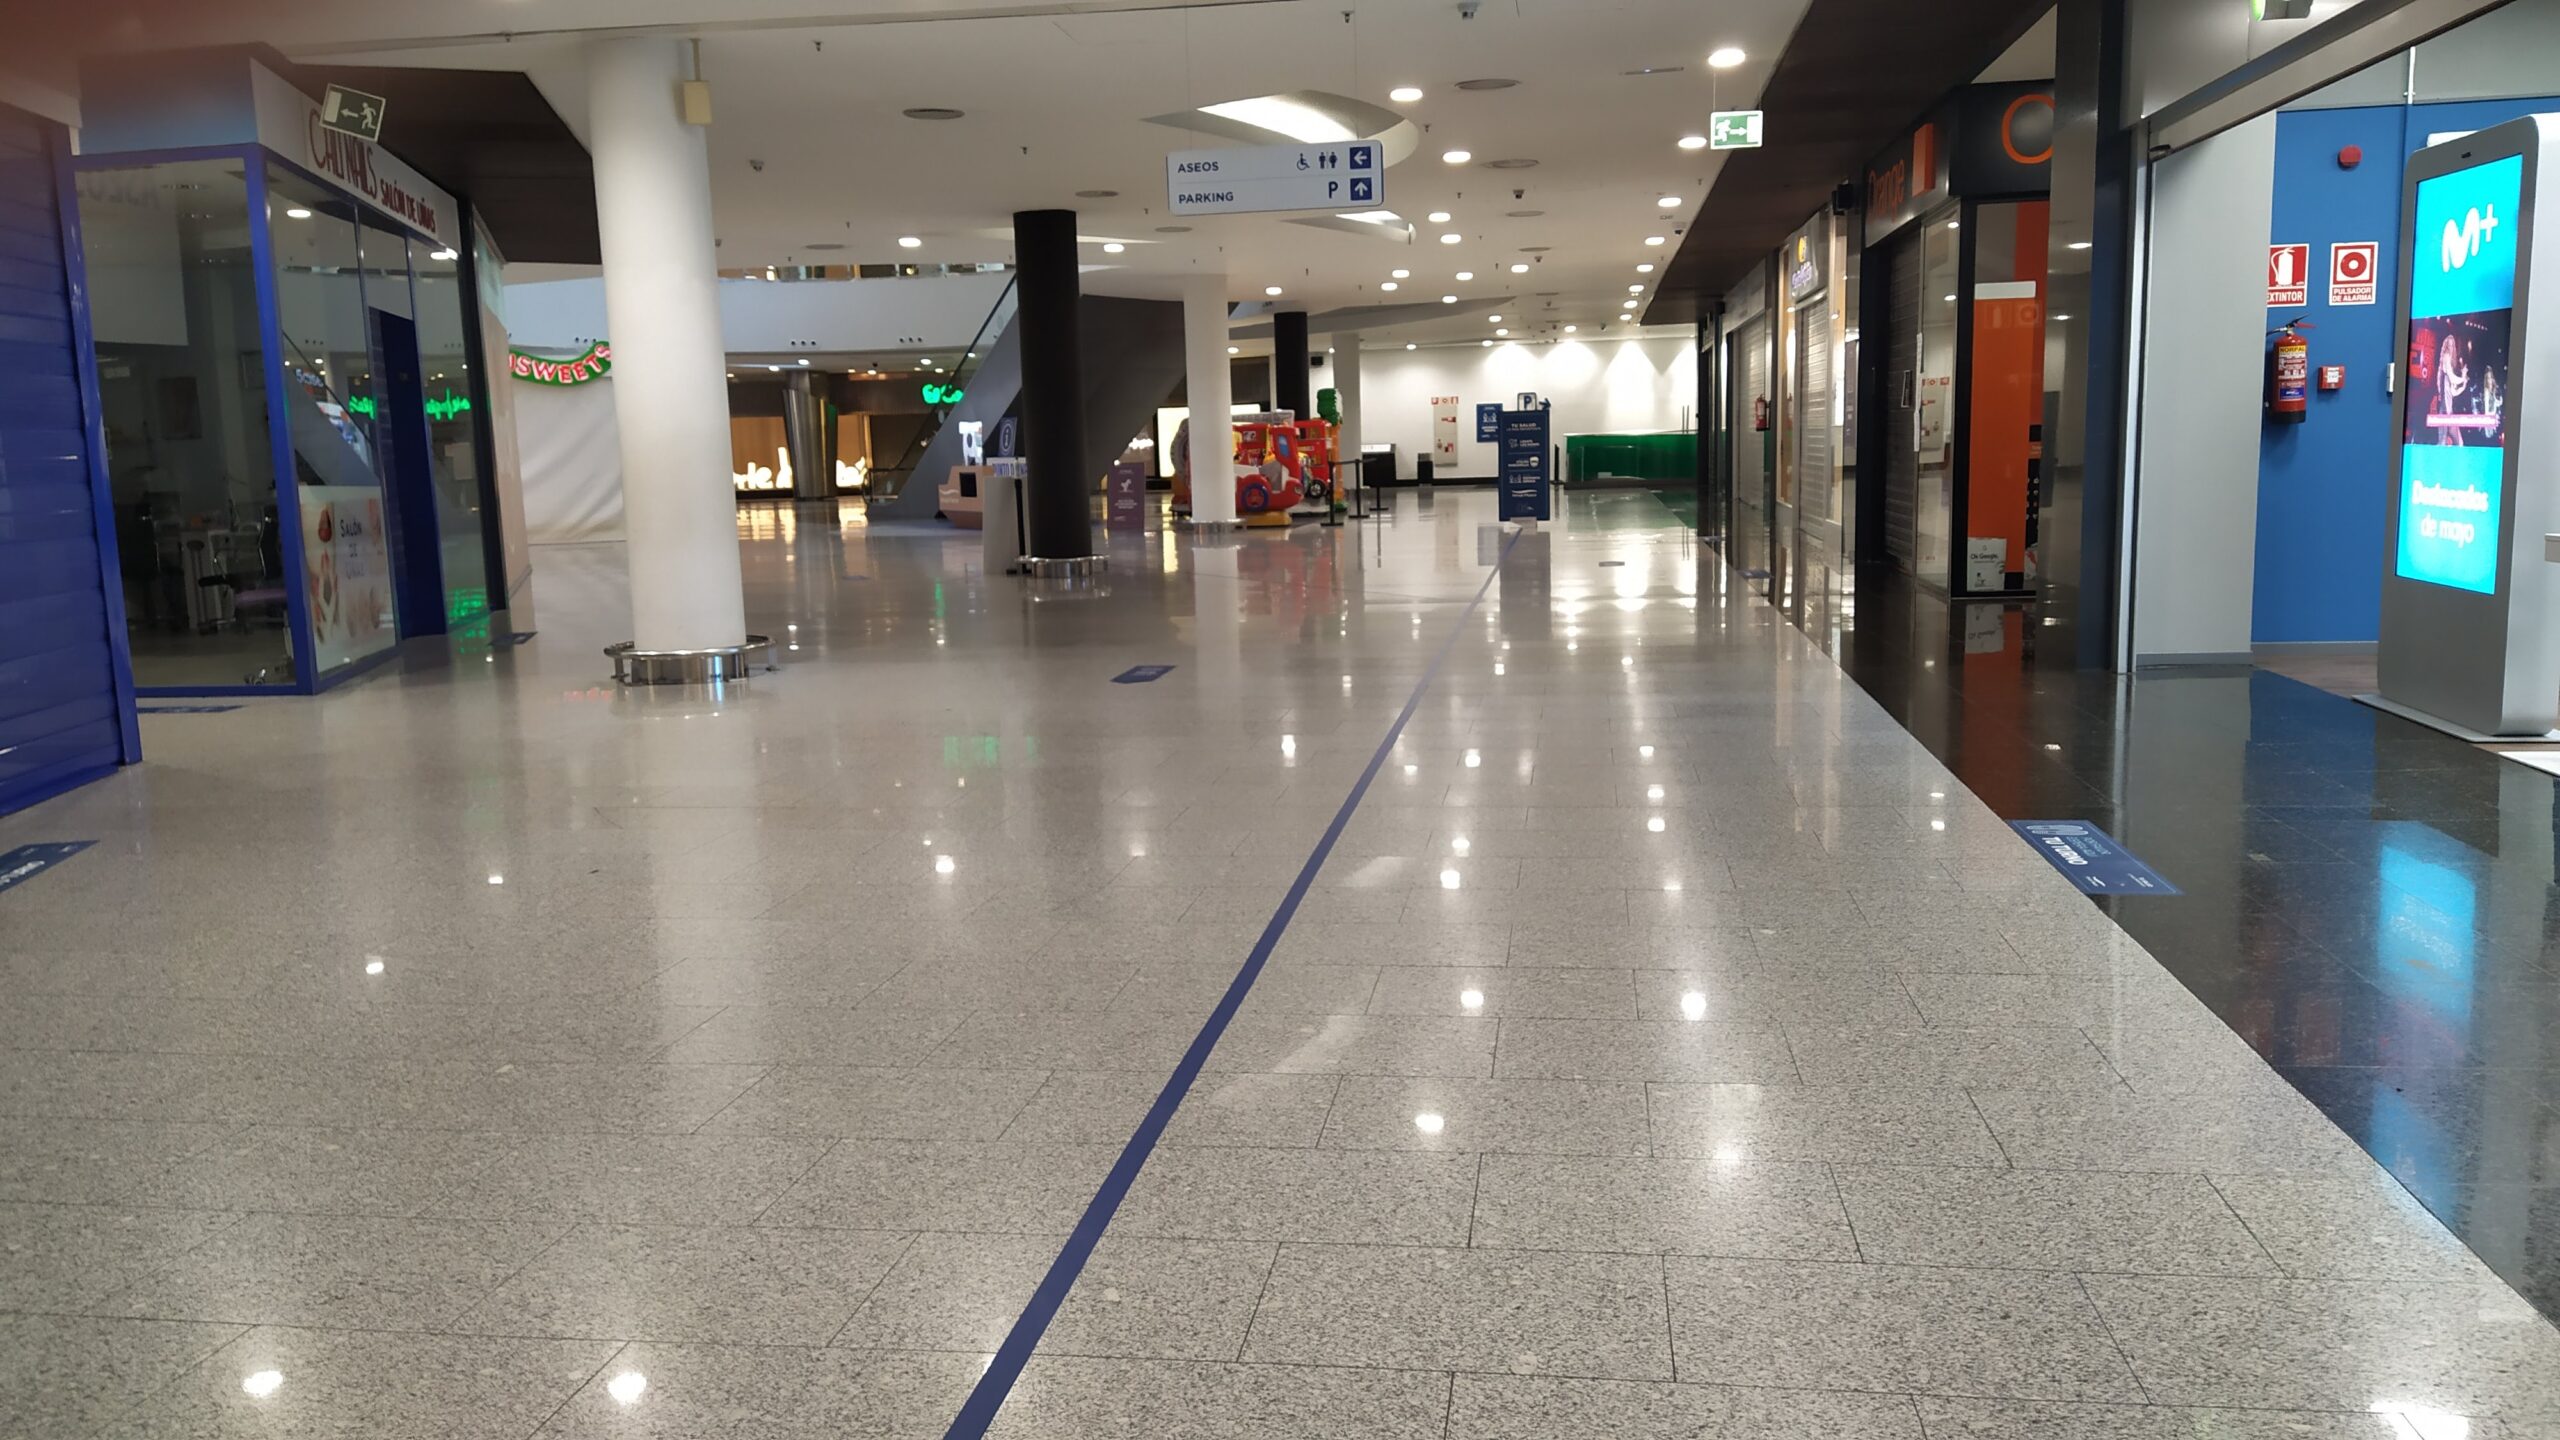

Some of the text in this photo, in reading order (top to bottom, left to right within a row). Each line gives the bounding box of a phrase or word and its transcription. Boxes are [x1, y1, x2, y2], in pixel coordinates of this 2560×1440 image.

[1177, 161, 1220, 174] ASEOS
[1178, 180, 1339, 205] PARKING P
[2333, 287, 2372, 296] PULSADOR
[2343, 294, 2373, 302] ALARMA
[1523, 395, 1533, 410] P
[2411, 479, 2489, 513] Destacados
[2421, 512, 2475, 549] de mayo
